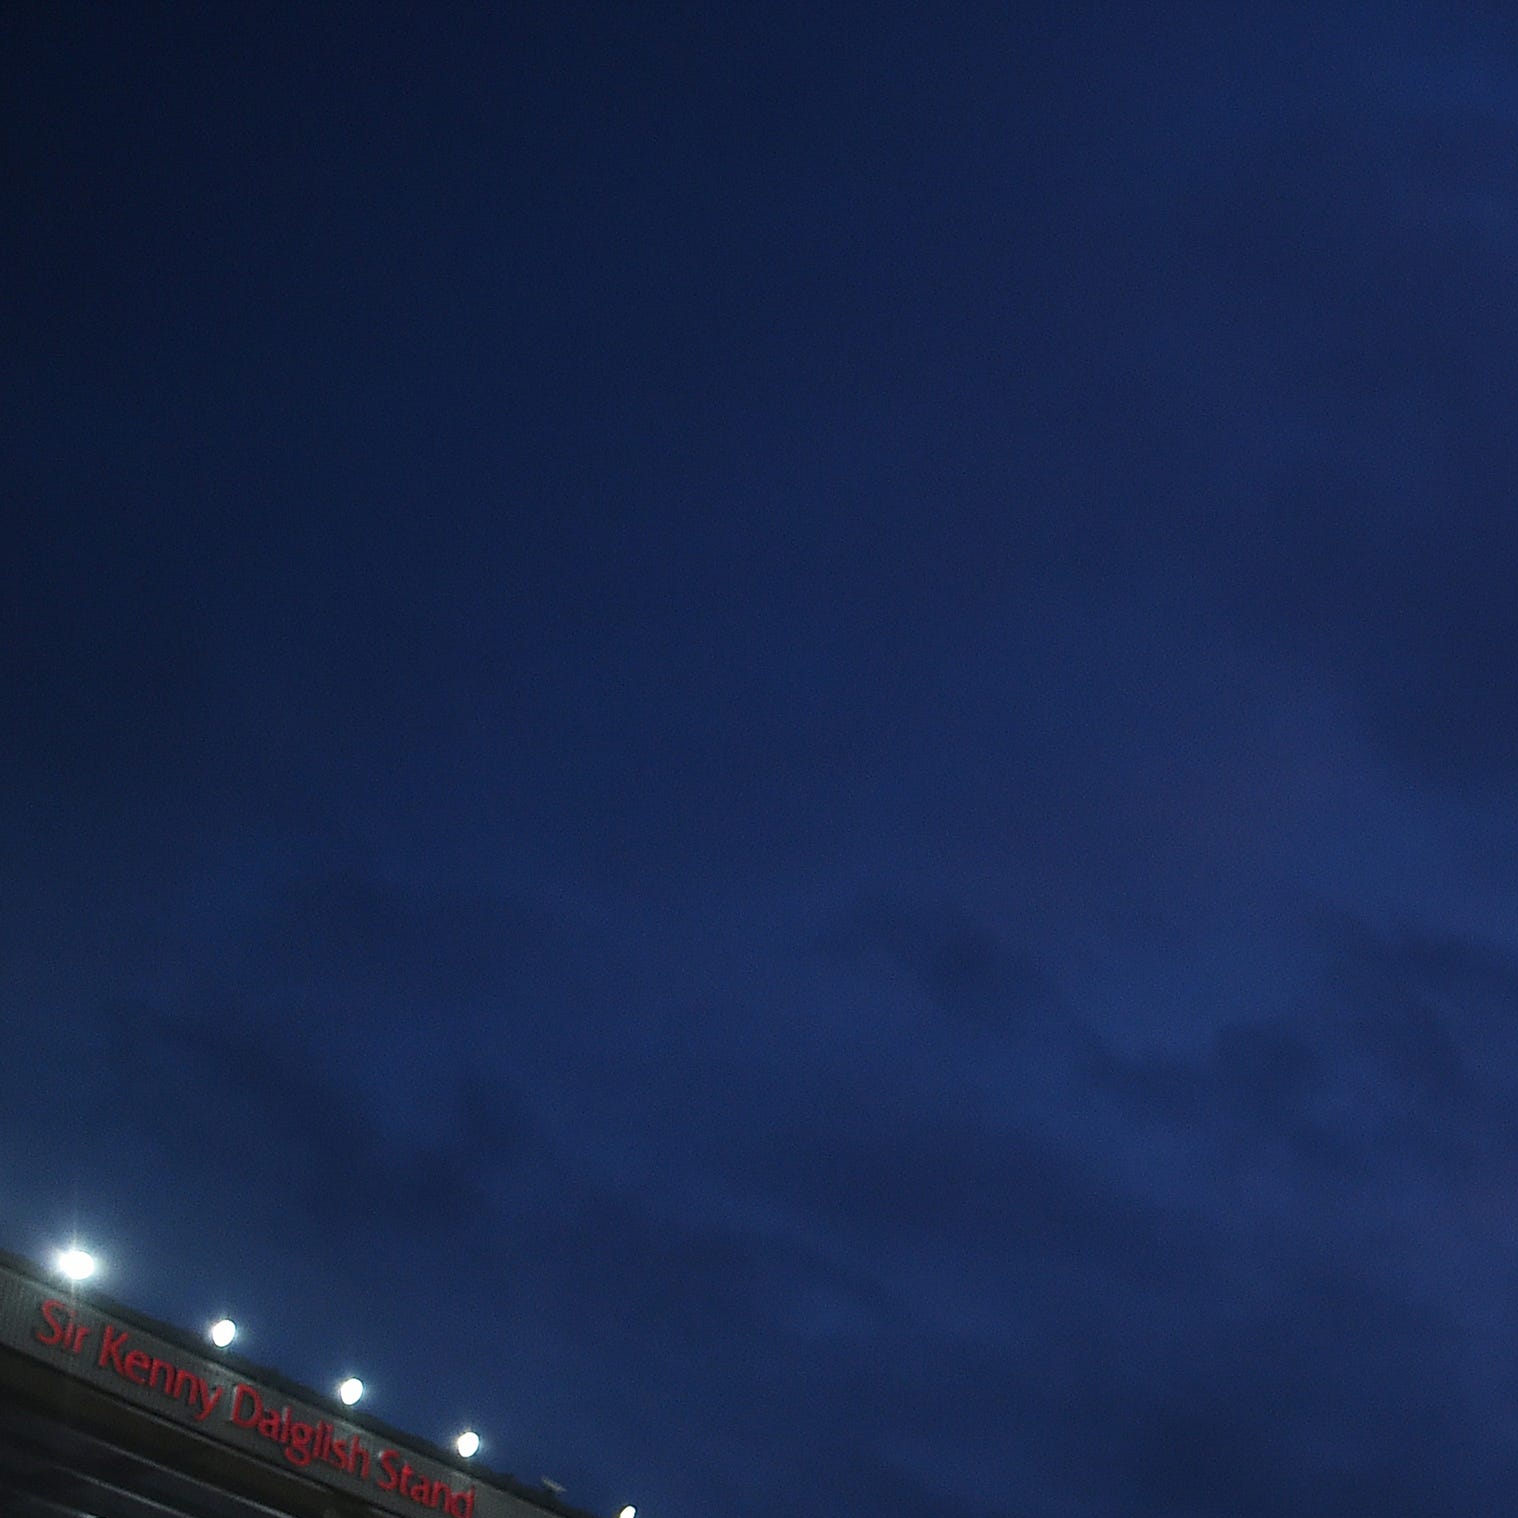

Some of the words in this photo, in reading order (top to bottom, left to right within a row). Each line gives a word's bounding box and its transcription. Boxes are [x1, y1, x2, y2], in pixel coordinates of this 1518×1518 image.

[37, 1299, 89, 1354] Sir
[98, 1324, 223, 1422] Kenny
[231, 1383, 371, 1481] Dalglish
